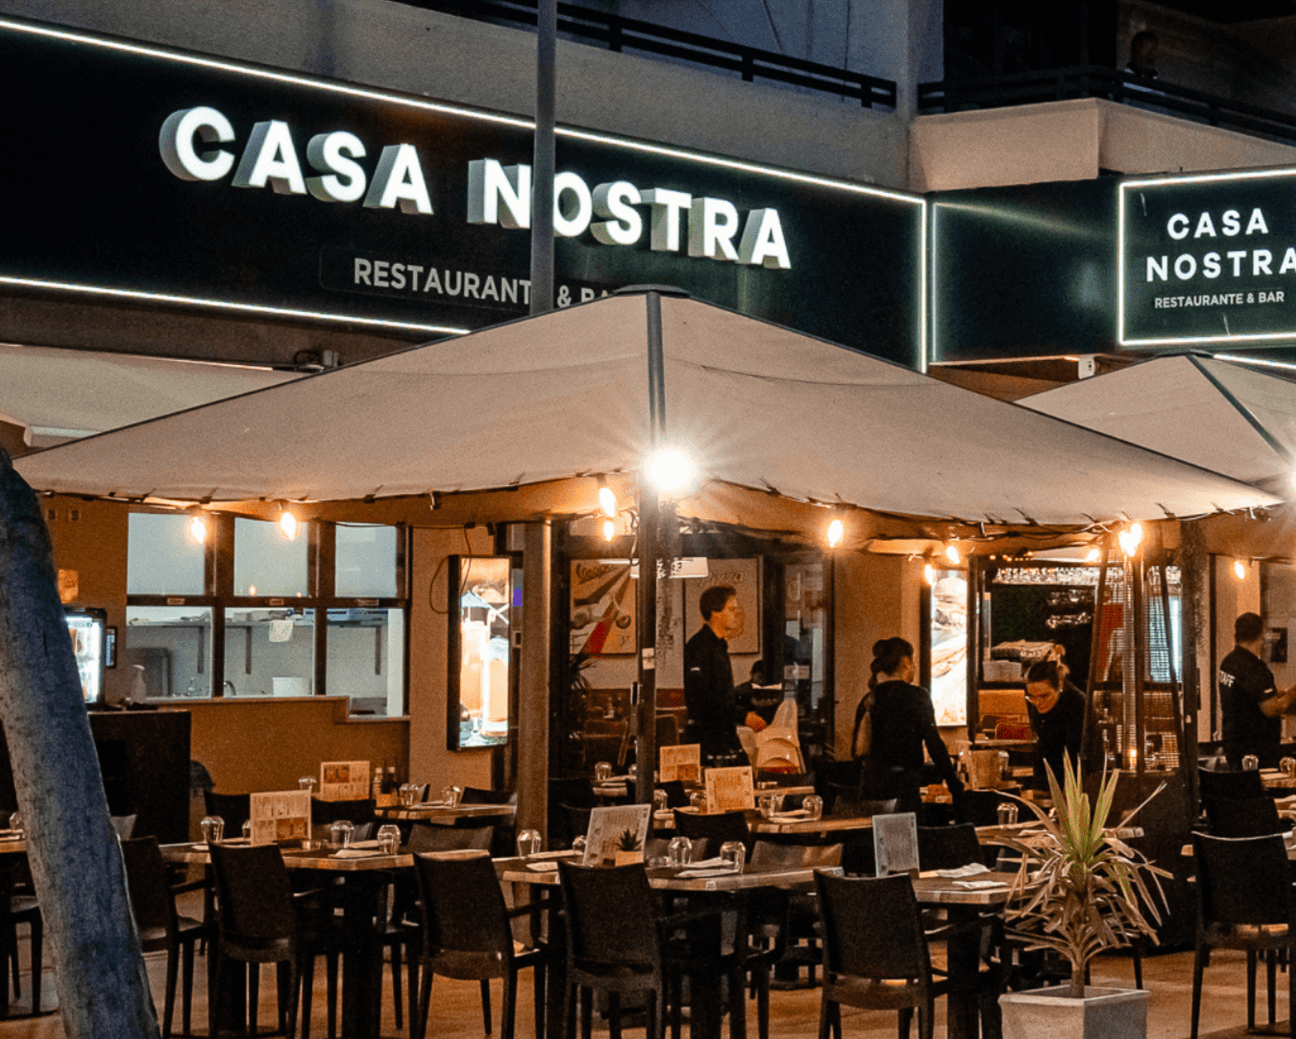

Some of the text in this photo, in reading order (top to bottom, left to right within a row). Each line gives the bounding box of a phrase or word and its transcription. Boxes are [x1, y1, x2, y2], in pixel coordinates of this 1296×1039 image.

[160, 106, 792, 270] CASA NOSTRA
[1166, 208, 1268, 240] CASA
[354, 257, 531, 305] RESTAURANT
[1154, 291, 1284, 308] RESTAURANTE & BAR
